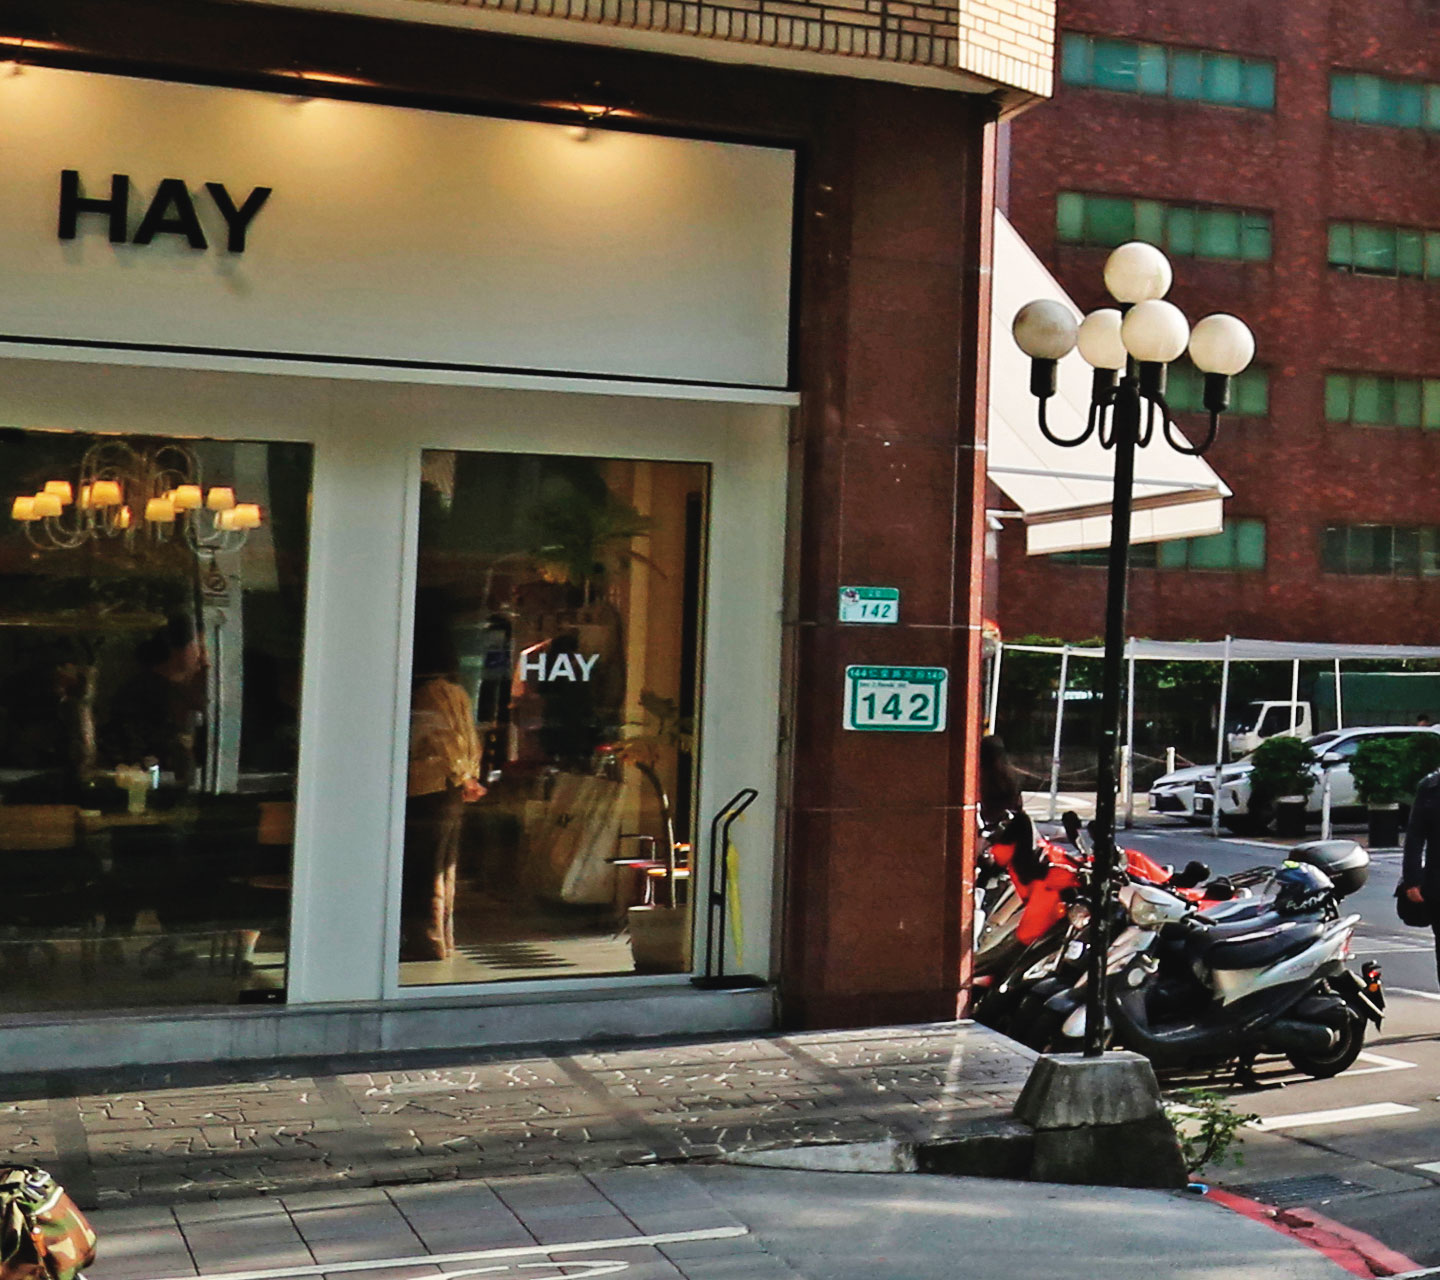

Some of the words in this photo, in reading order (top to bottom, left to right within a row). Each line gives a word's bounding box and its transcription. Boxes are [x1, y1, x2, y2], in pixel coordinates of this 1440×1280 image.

[58, 169, 273, 253] HAY
[861, 603, 892, 618] 142
[519, 653, 600, 682] HAY
[862, 692, 930, 722] 142
